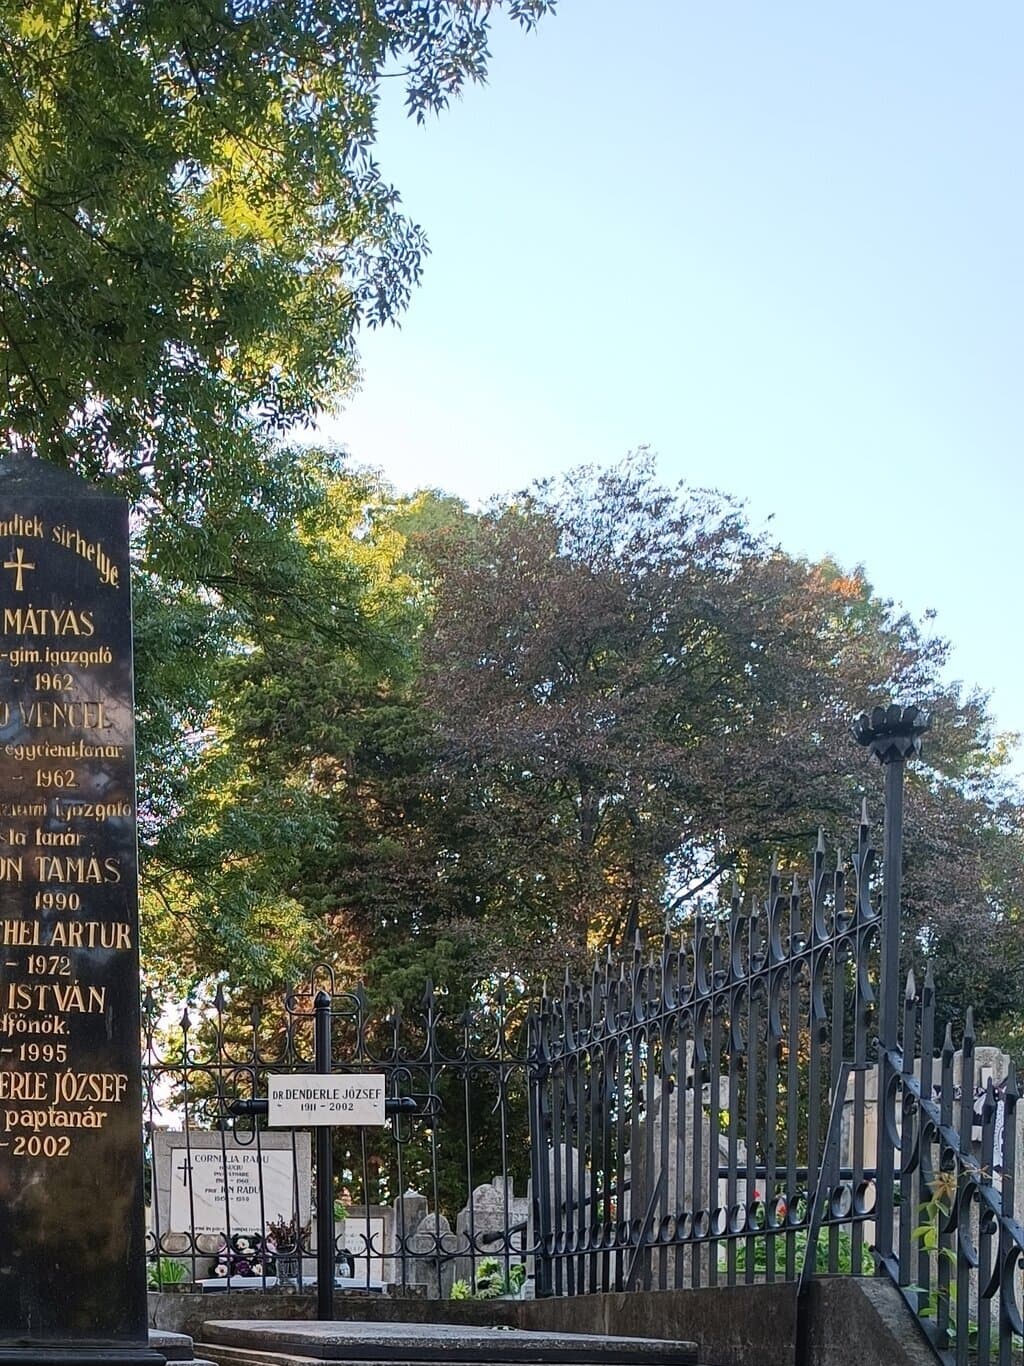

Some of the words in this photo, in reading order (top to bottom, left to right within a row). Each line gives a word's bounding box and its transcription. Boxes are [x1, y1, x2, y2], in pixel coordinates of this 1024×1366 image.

[3, 602, 95, 637] MÁTYÁS
[35, 673, 74, 691] 1962
[34, 851, 121, 884] TAMÁS
[35, 891, 80, 911] 1990
[27, 955, 71, 975] 1972
[8, 981, 106, 1013] ISTVÁN
[19, 1043, 67, 1062] 1995
[53, 1068, 129, 1105] JÓZSEF
[286, 1089, 339, 1100] DENDERLE
[342, 1087, 382, 1099] JÓZSEF
[301, 1103, 316, 1111] 1911
[329, 1103, 354, 1111] 2002
[5, 1104, 107, 1132] paptanár
